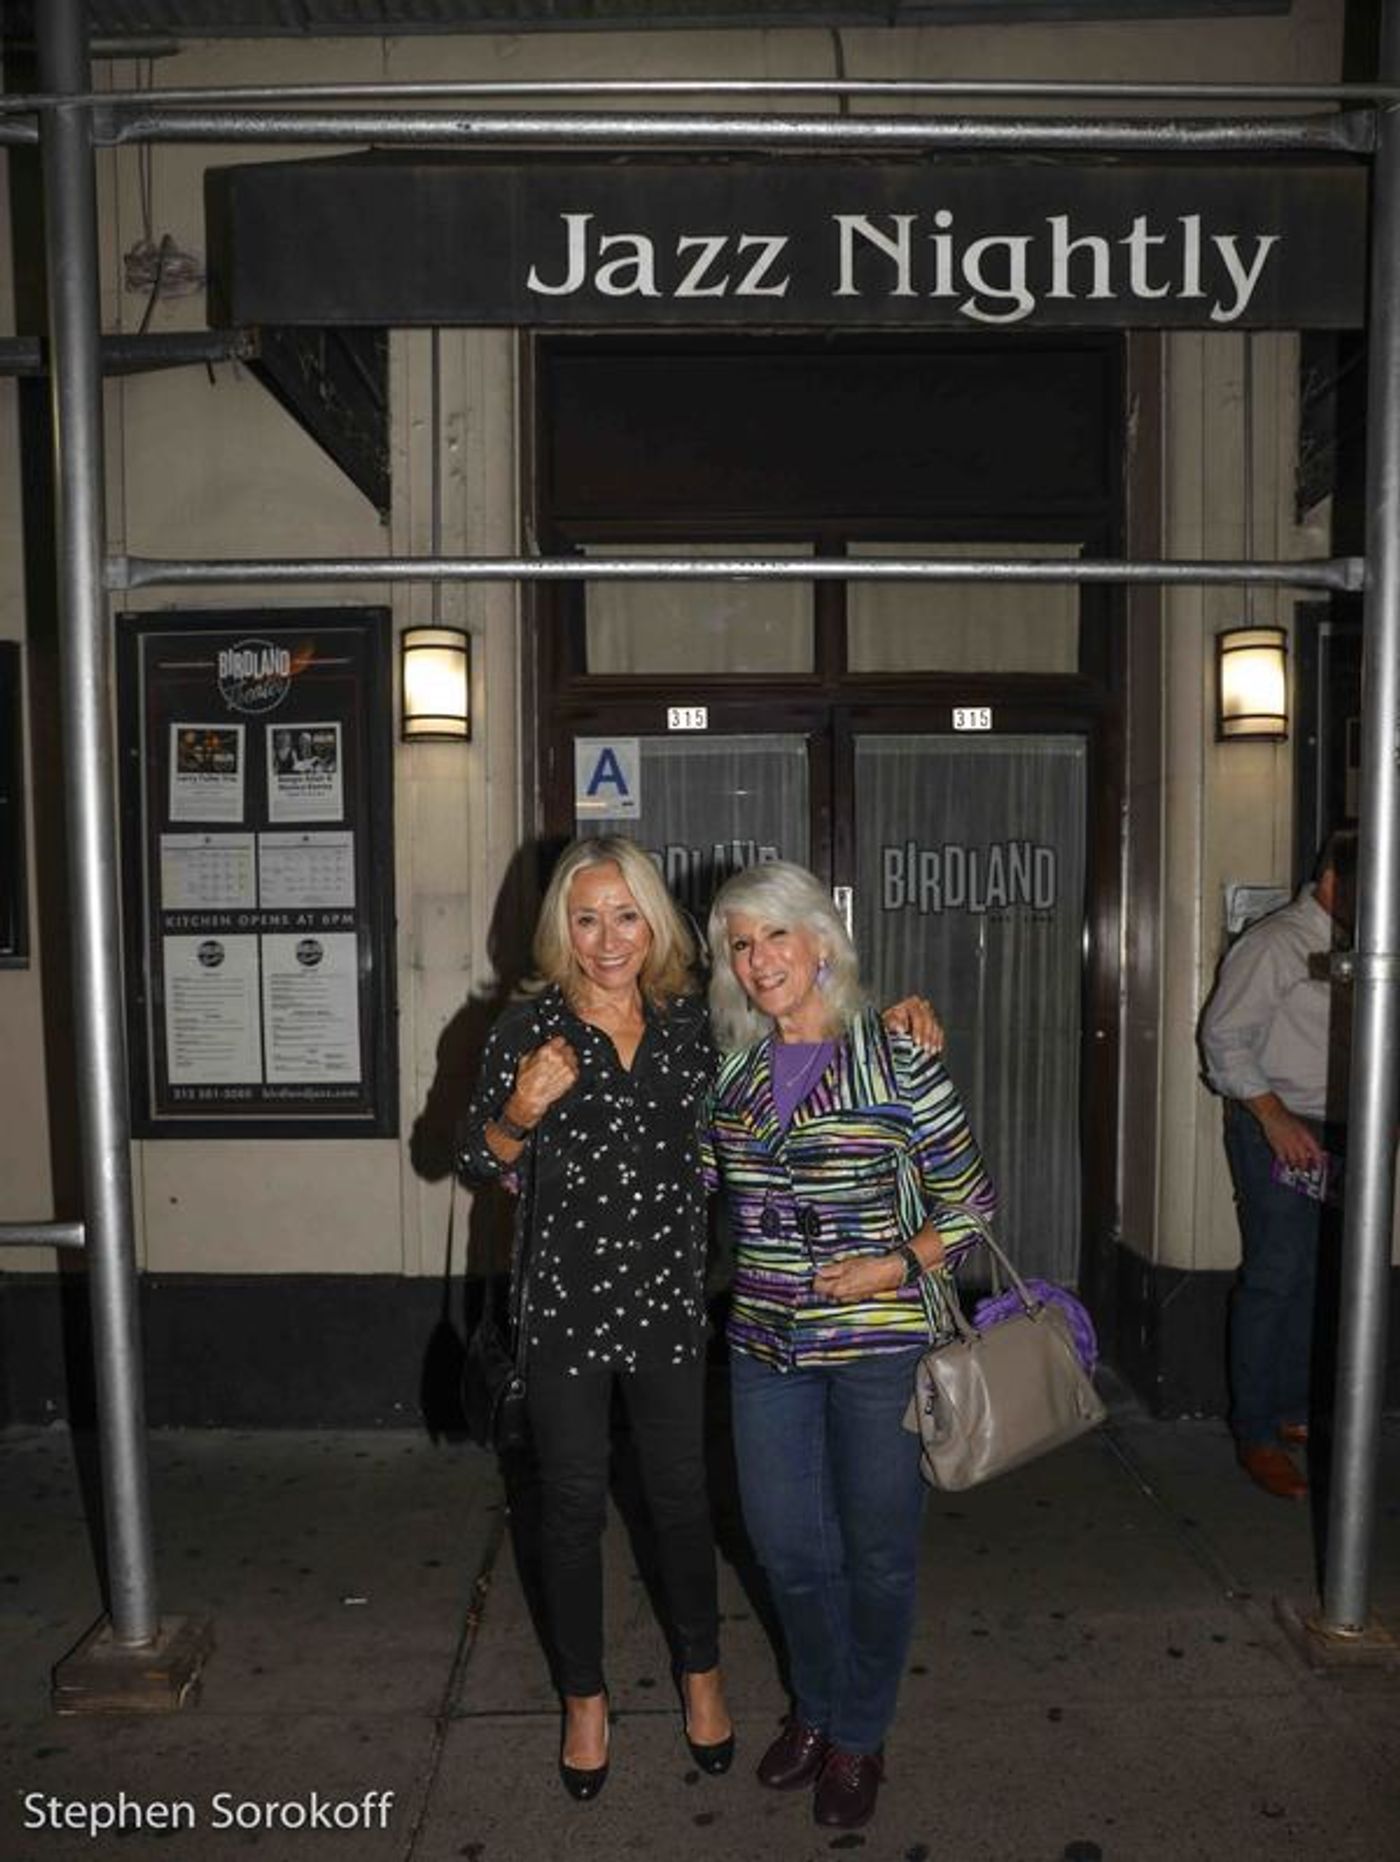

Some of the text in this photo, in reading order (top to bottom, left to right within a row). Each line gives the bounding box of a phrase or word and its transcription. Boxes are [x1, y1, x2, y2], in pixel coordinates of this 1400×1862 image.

[526, 209, 1281, 323] Jazz Nightly
[219, 648, 290, 680] BIRDLAND
[671, 709, 704, 727] 315
[956, 709, 988, 727] 315
[587, 746, 629, 796] A
[882, 841, 1057, 915] BIRDLAND
[165, 914, 231, 927] KITCHEN
[238, 914, 289, 926] OPENS
[296, 913, 315, 925] AT
